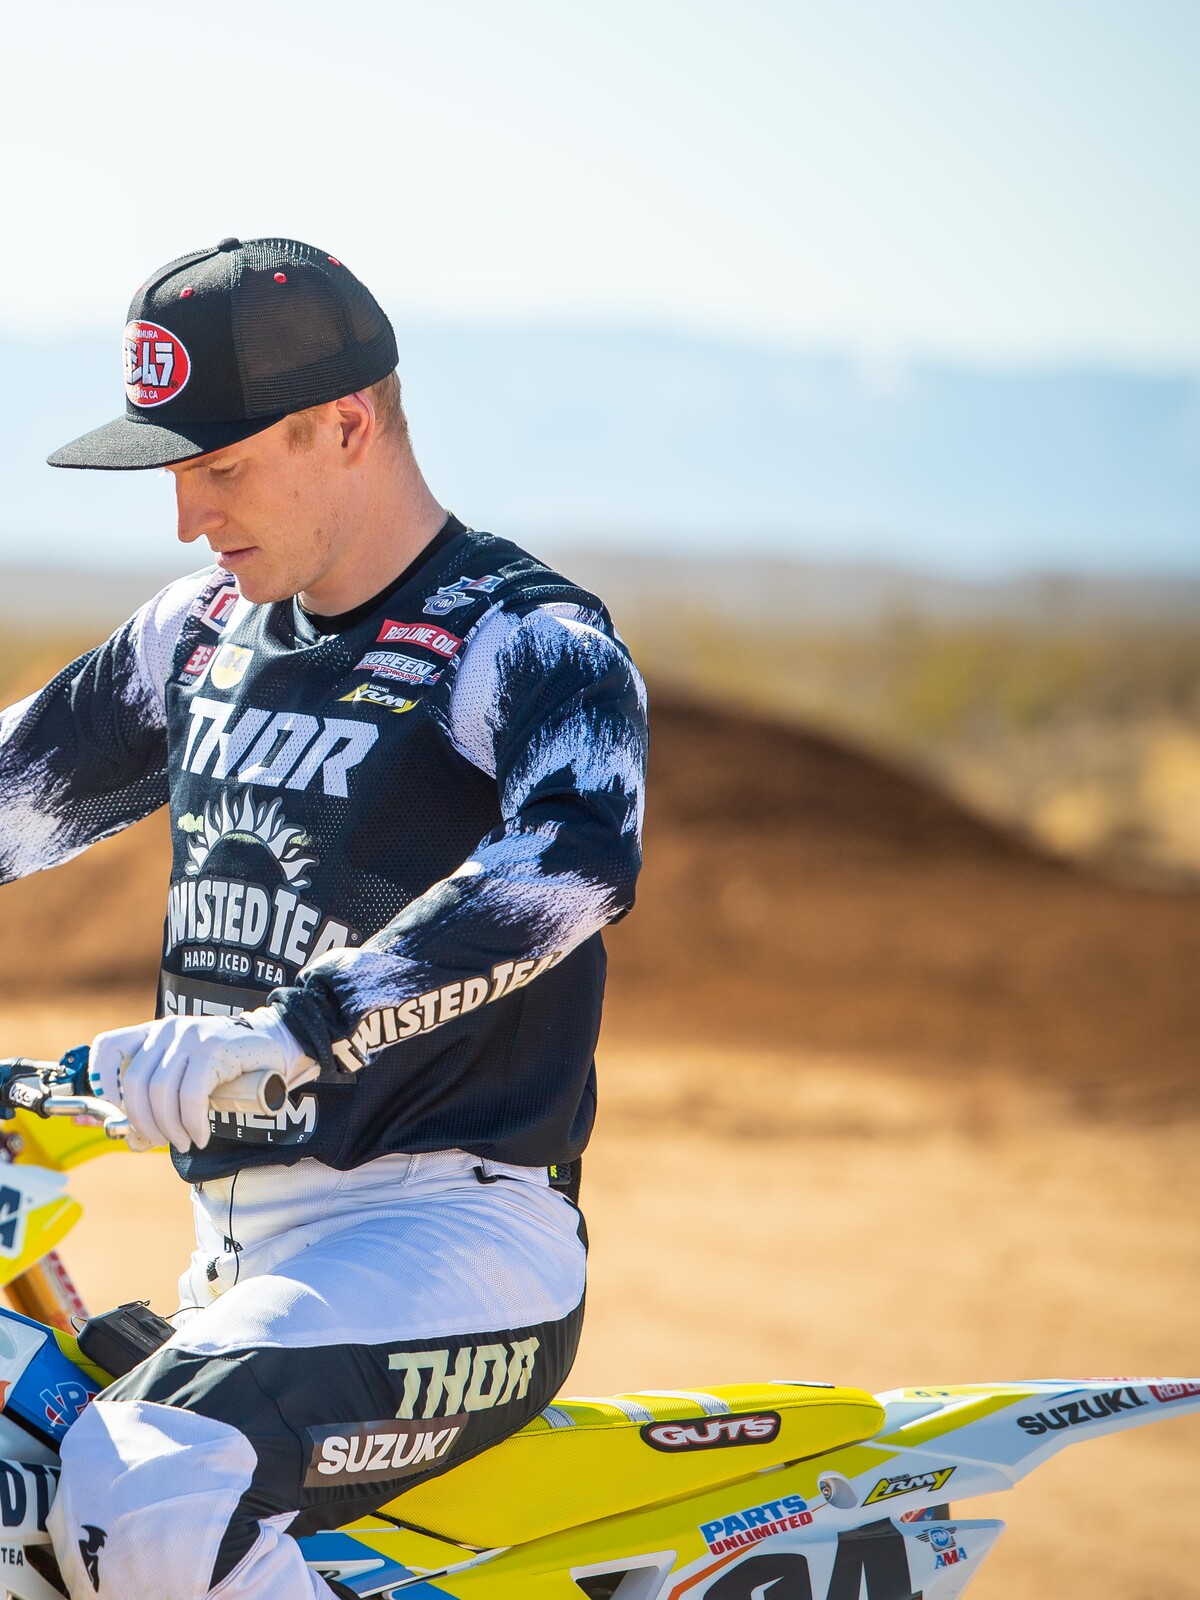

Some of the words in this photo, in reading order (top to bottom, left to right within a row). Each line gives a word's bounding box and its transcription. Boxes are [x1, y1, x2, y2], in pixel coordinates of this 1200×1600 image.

[383, 626, 406, 640] RED
[404, 627, 437, 645] LINE
[431, 634, 458, 655] OIL
[369, 685, 389, 693] SUZUKI
[181, 696, 379, 798] THOR
[184, 951, 215, 968] HARD
[220, 952, 250, 973] ICED
[257, 960, 284, 985] TEA
[331, 977, 489, 1073] TWISTED
[388, 1337, 540, 1420] THOR
[650, 1416, 777, 1446] GUTS
[1017, 1387, 1148, 1435] SUZUKI
[317, 1427, 460, 1475] SUZUKI
[699, 1494, 808, 1544] PARTS
[708, 1511, 813, 1556] UNLIMITED
[0, 1548, 24, 1566] TEA
[934, 1547, 968, 1569] AMA
